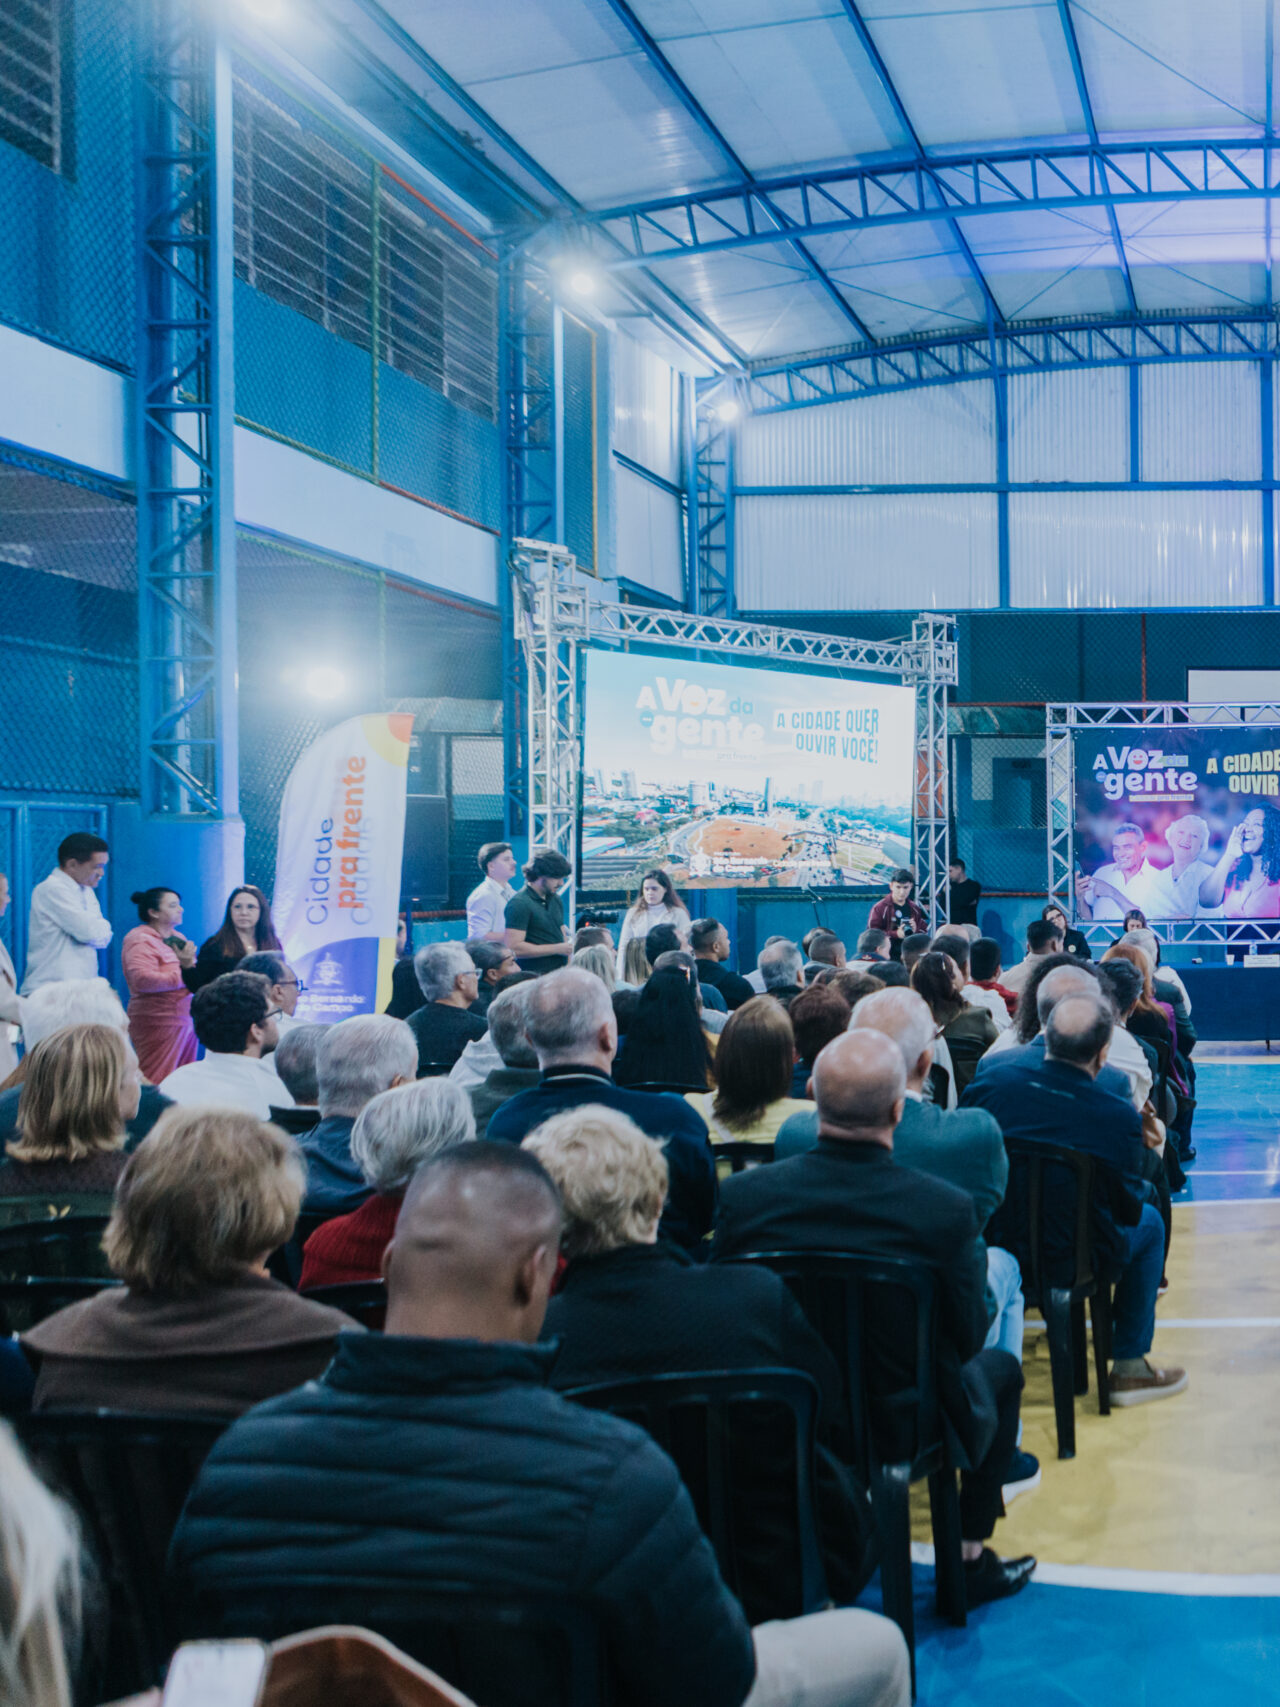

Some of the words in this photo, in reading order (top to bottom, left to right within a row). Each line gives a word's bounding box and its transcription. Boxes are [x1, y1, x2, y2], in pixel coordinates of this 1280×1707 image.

[636, 686, 657, 710] A
[729, 697, 754, 714] da
[650, 715, 765, 755] gente
[777, 712, 785, 728] A
[792, 711, 841, 731] CIDADE
[846, 709, 879, 733] QUER
[796, 733, 836, 756] OUVIR
[842, 730, 879, 764] VOCÊ!
[1092, 754, 1109, 770] A
[1206, 758, 1218, 774] A
[1104, 768, 1198, 800] gente
[1228, 774, 1279, 796] OUVIR
[336, 756, 366, 849] frente
[305, 817, 333, 925] Cidade
[338, 856, 365, 908] pra
